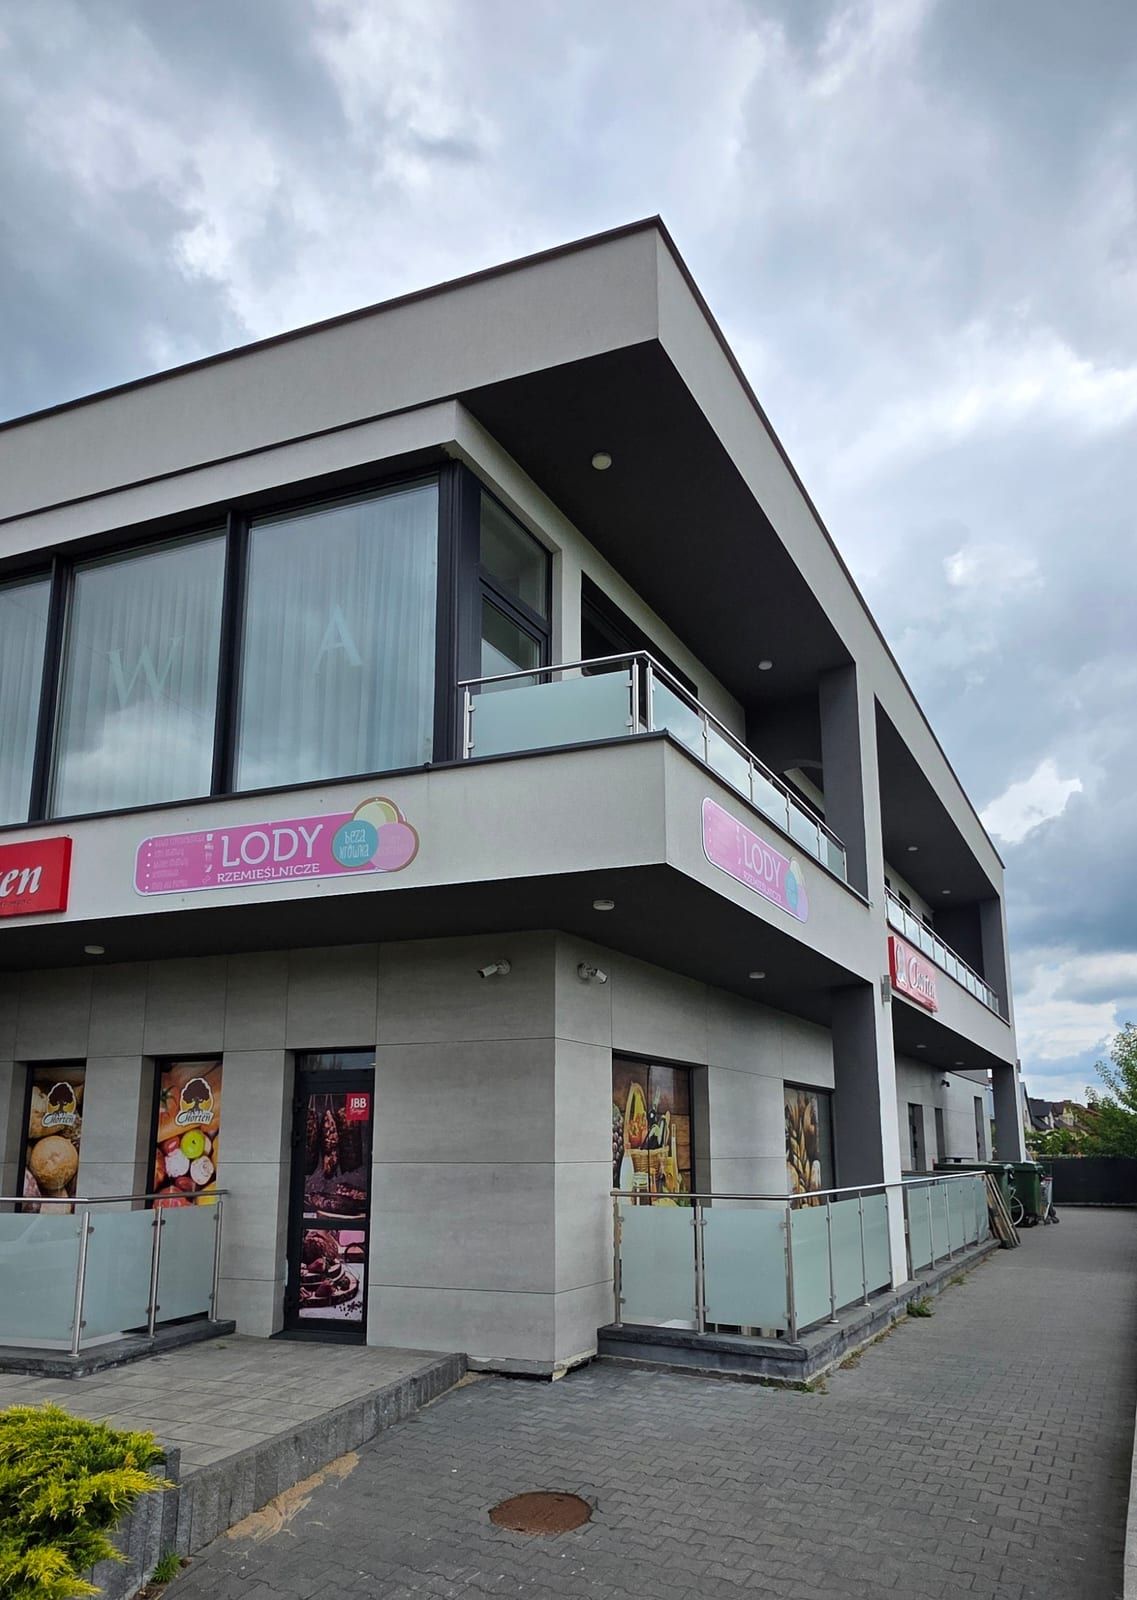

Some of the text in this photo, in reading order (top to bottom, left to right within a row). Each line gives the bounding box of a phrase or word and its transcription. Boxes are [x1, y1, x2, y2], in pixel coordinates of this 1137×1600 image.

[220, 823, 324, 868] LODY
[742, 832, 781, 888] LODY
[0, 865, 42, 897] en
[216, 862, 321, 884] RZEMIEŚLNICZE
[350, 1097, 367, 1109] JBB
